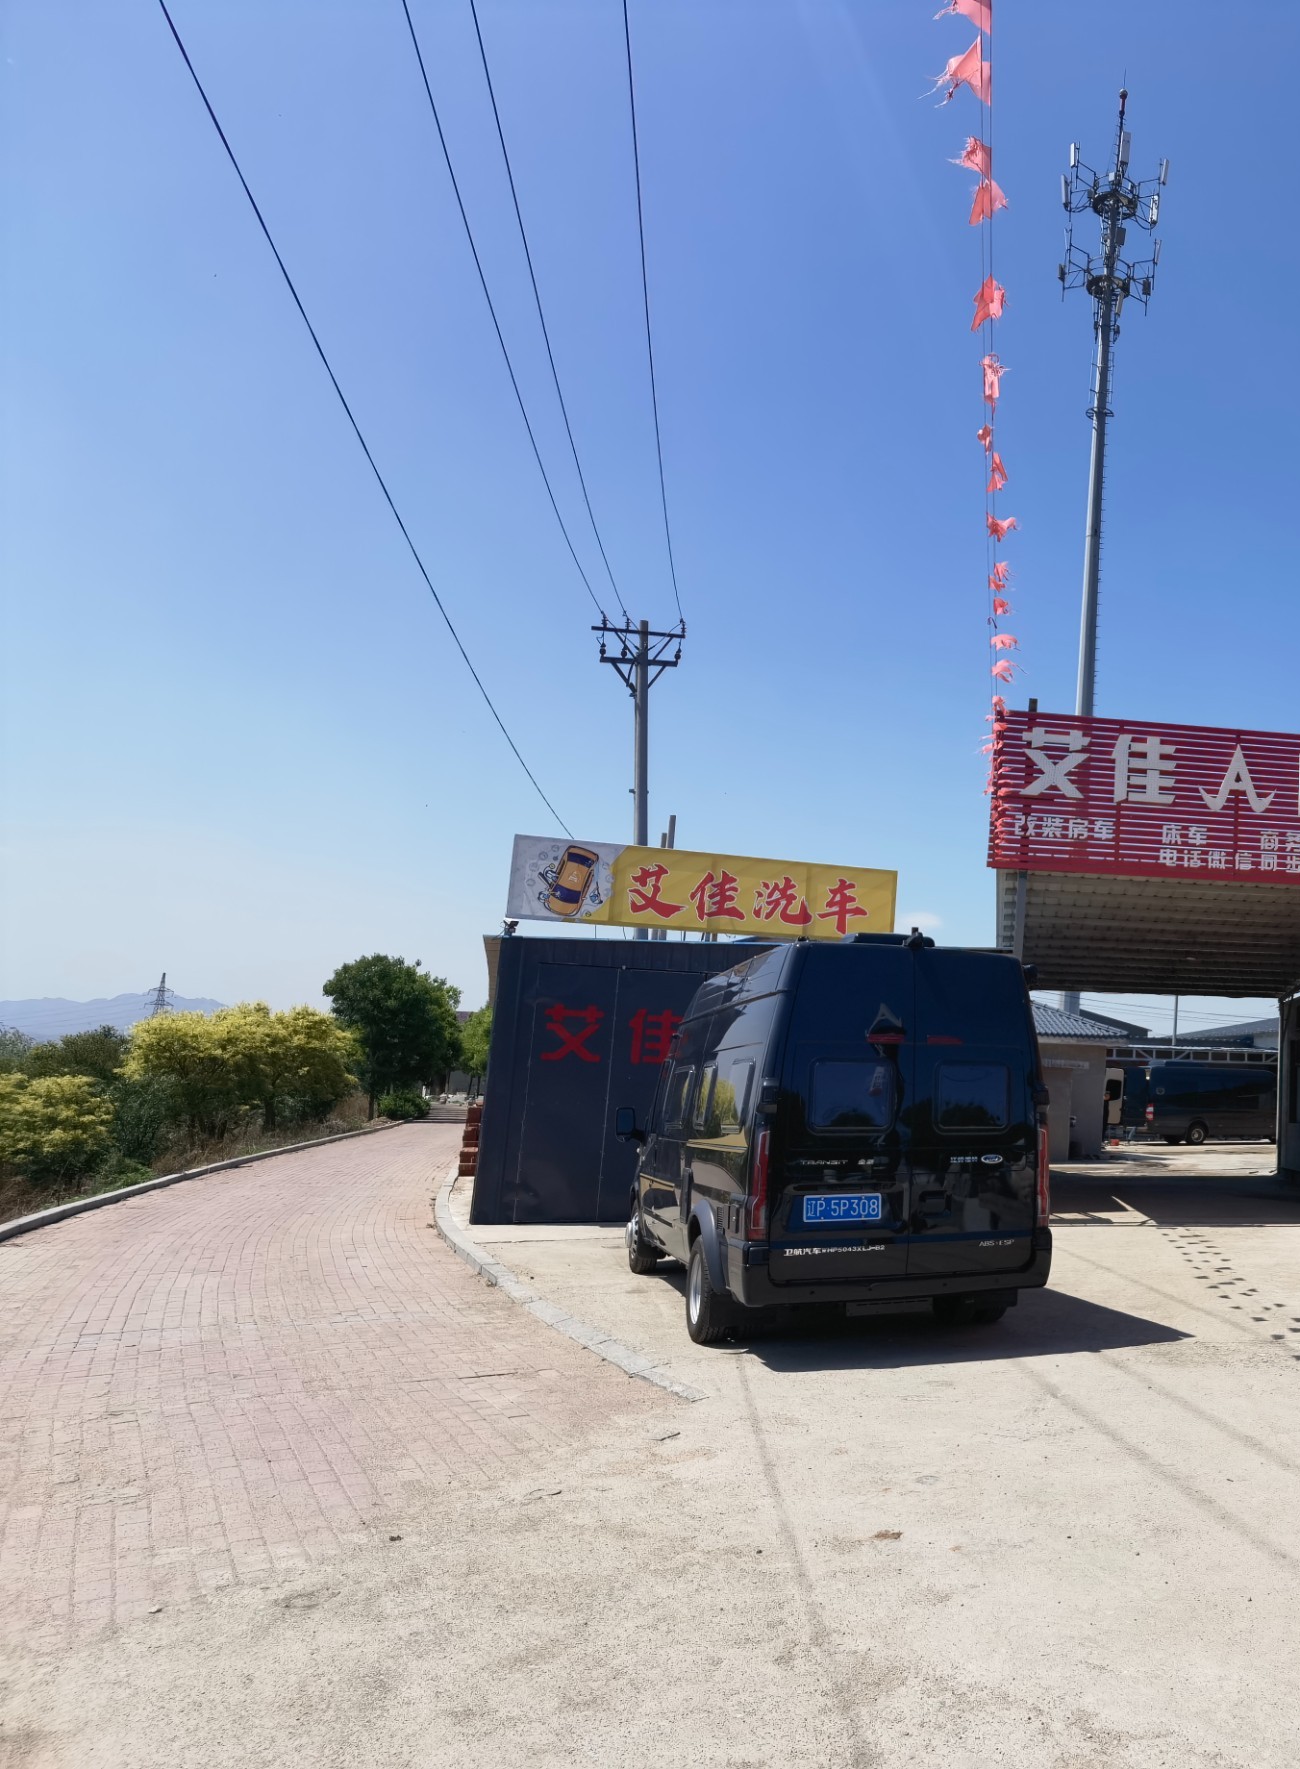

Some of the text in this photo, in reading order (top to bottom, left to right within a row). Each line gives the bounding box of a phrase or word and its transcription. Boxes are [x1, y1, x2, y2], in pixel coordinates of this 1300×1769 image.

[1014, 814, 1116, 842] 改装房车
[1162, 824, 1208, 846] 床车
[627, 863, 868, 934] 艾佳洗车
[540, 1003, 682, 1065] 艾佳
